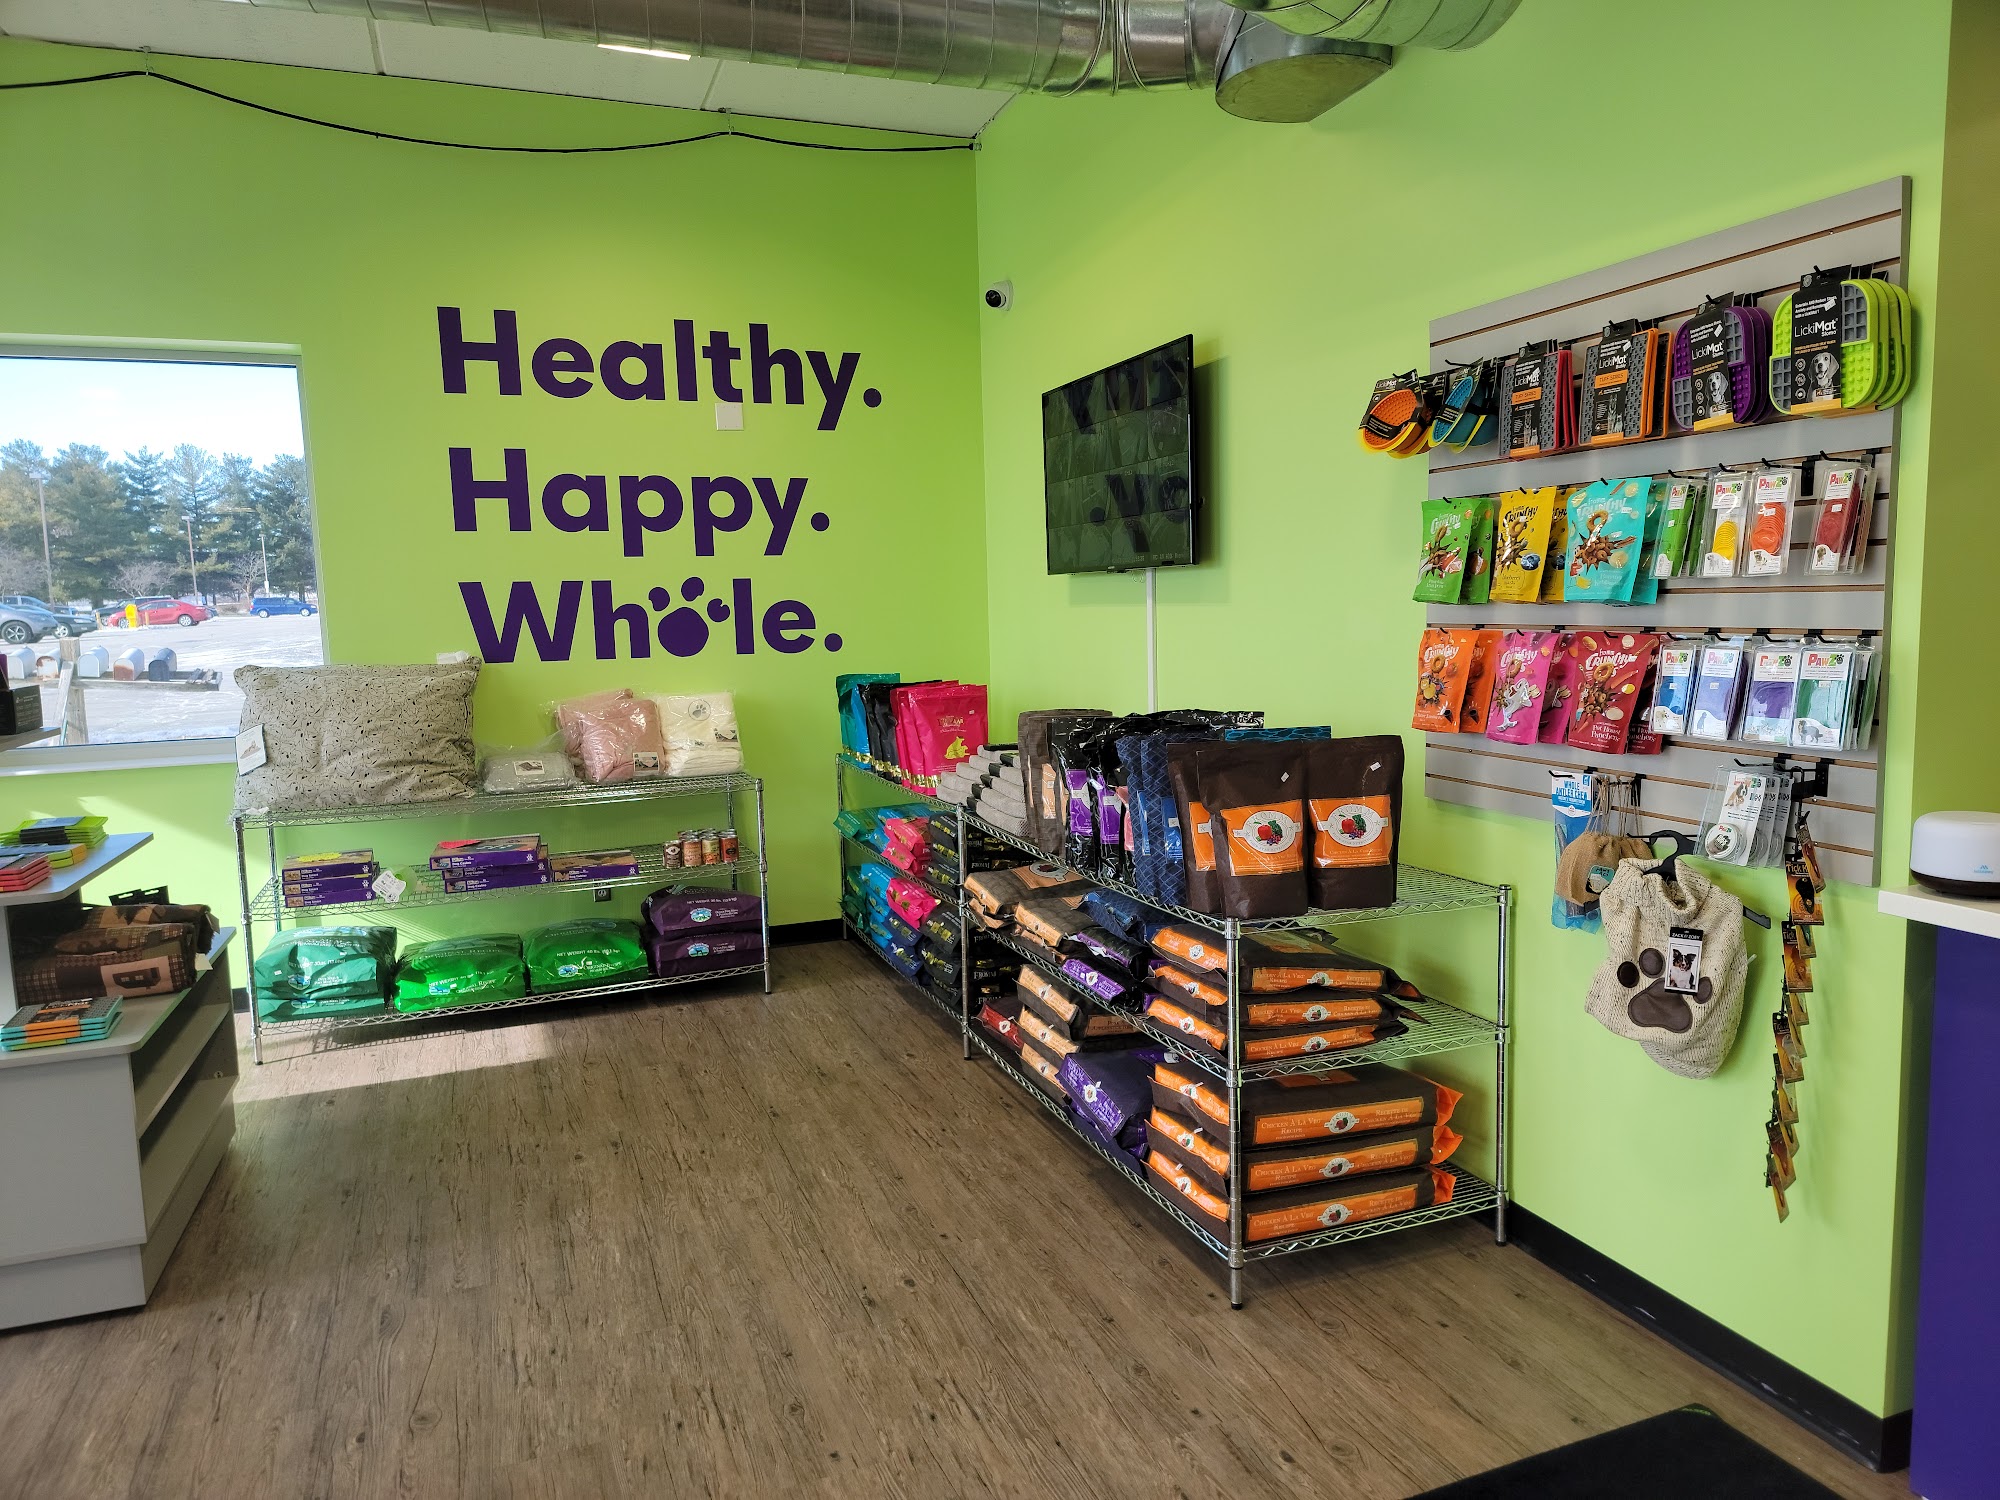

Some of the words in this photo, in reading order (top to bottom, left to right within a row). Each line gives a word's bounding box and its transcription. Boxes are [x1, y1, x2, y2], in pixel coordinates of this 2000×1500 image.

[1794, 319, 1837, 338] LickiMat
[1692, 341, 1724, 360] LickiMat
[437, 306, 882, 431] Healthy.
[1598, 355, 1628, 369] LickiMat
[449, 447, 830, 557] Happy.
[1786, 864, 1802, 872] Tick
